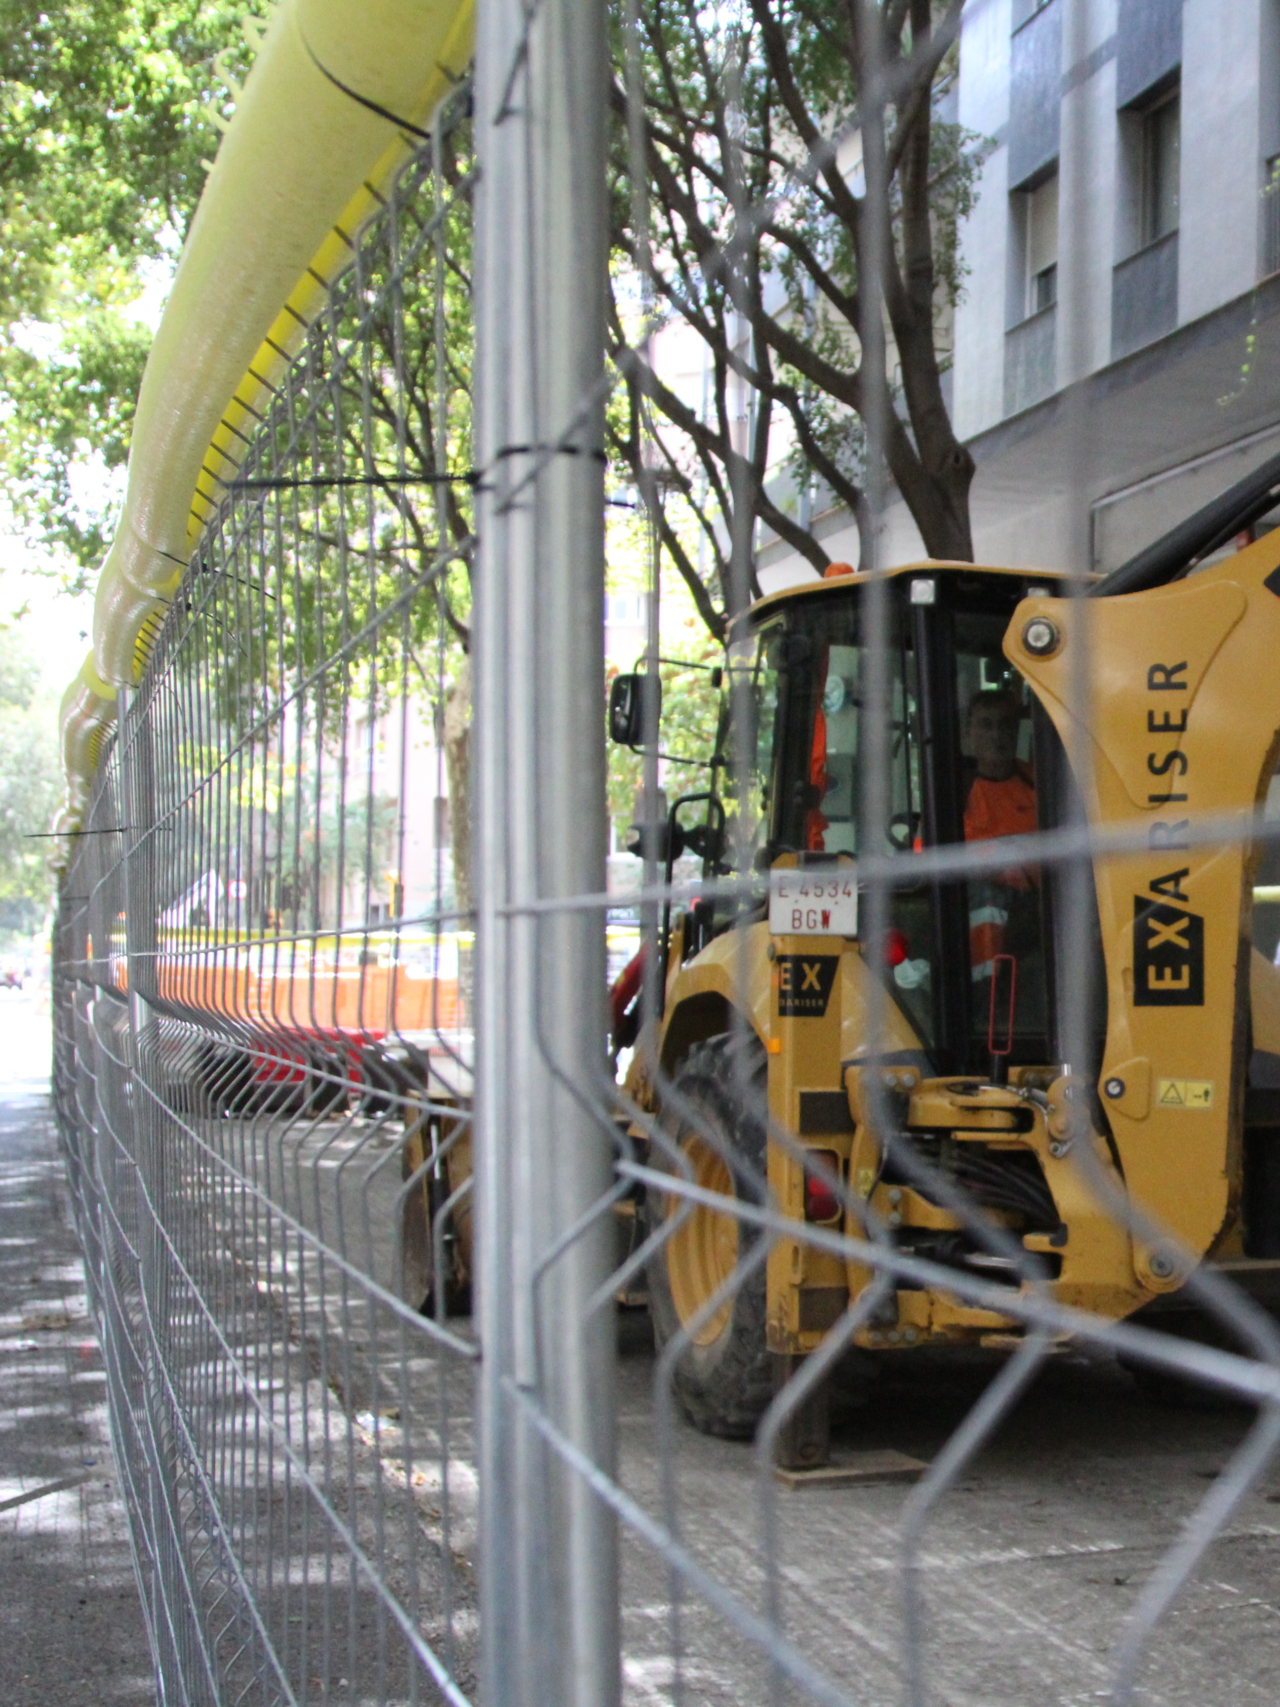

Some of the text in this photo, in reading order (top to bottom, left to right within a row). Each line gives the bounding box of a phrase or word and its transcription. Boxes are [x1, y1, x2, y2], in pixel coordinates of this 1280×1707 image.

[1147, 660, 1190, 989] EXARISER
[799, 877, 852, 898] 4534
[791, 908, 832, 930] BGW
[780, 962, 821, 990] EX
